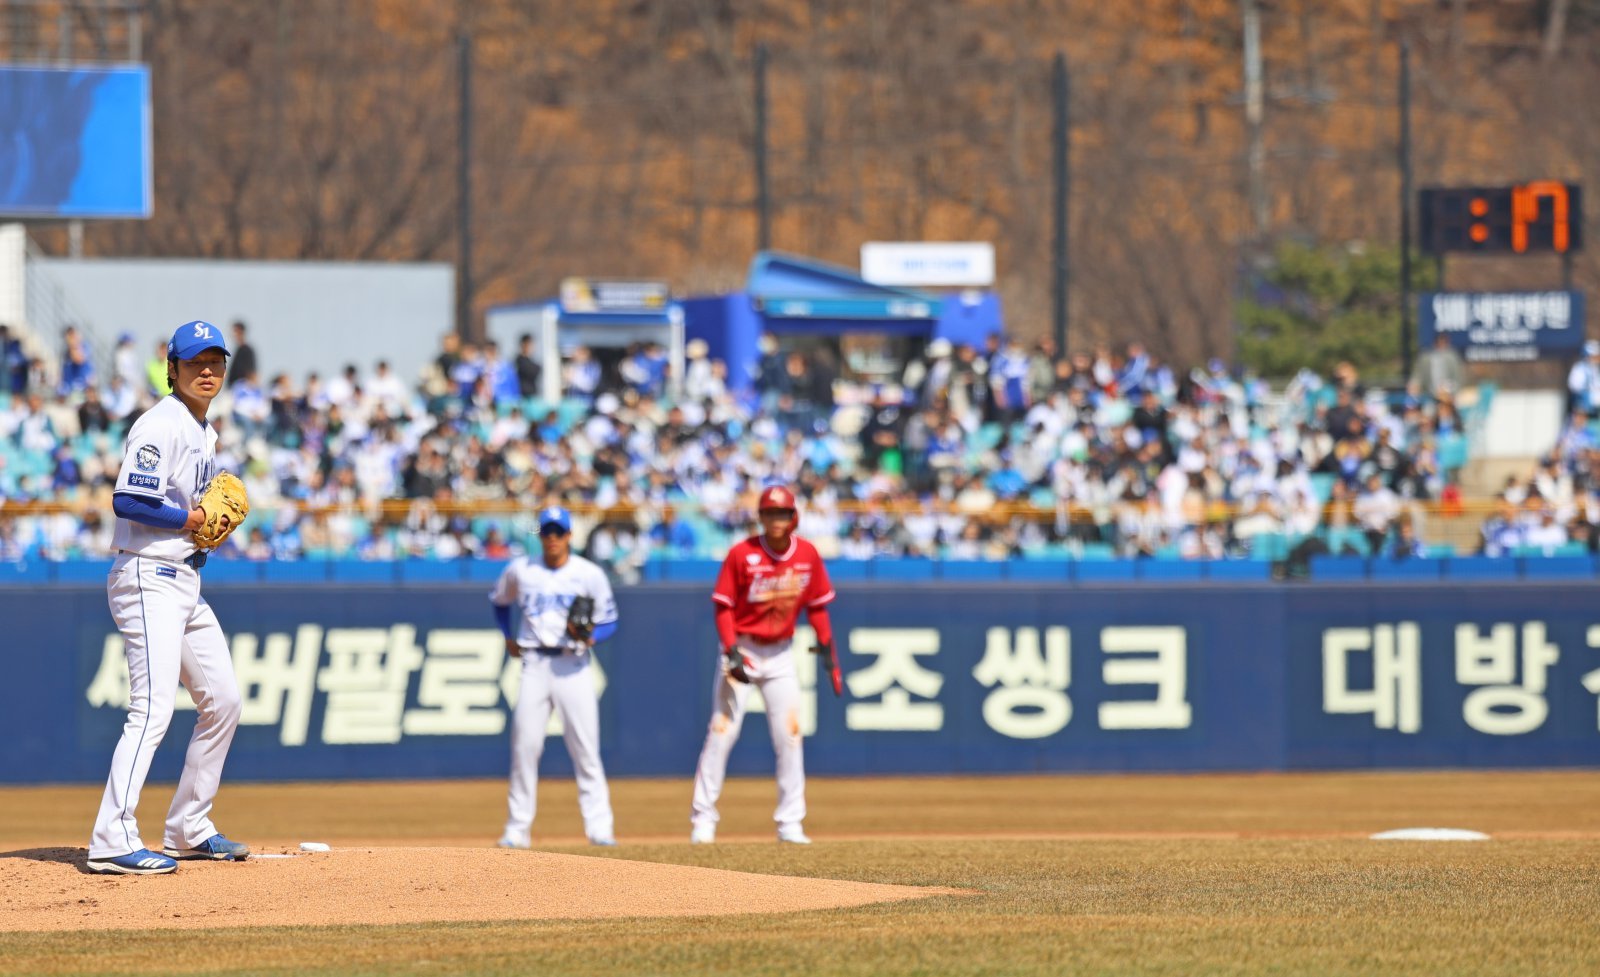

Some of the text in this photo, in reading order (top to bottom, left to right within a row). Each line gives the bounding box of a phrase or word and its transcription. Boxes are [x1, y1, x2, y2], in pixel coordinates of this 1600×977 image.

[194, 322, 213, 340] SL
[131, 474, 159, 486] 삼성화재
[86, 623, 506, 746] 버팔로
